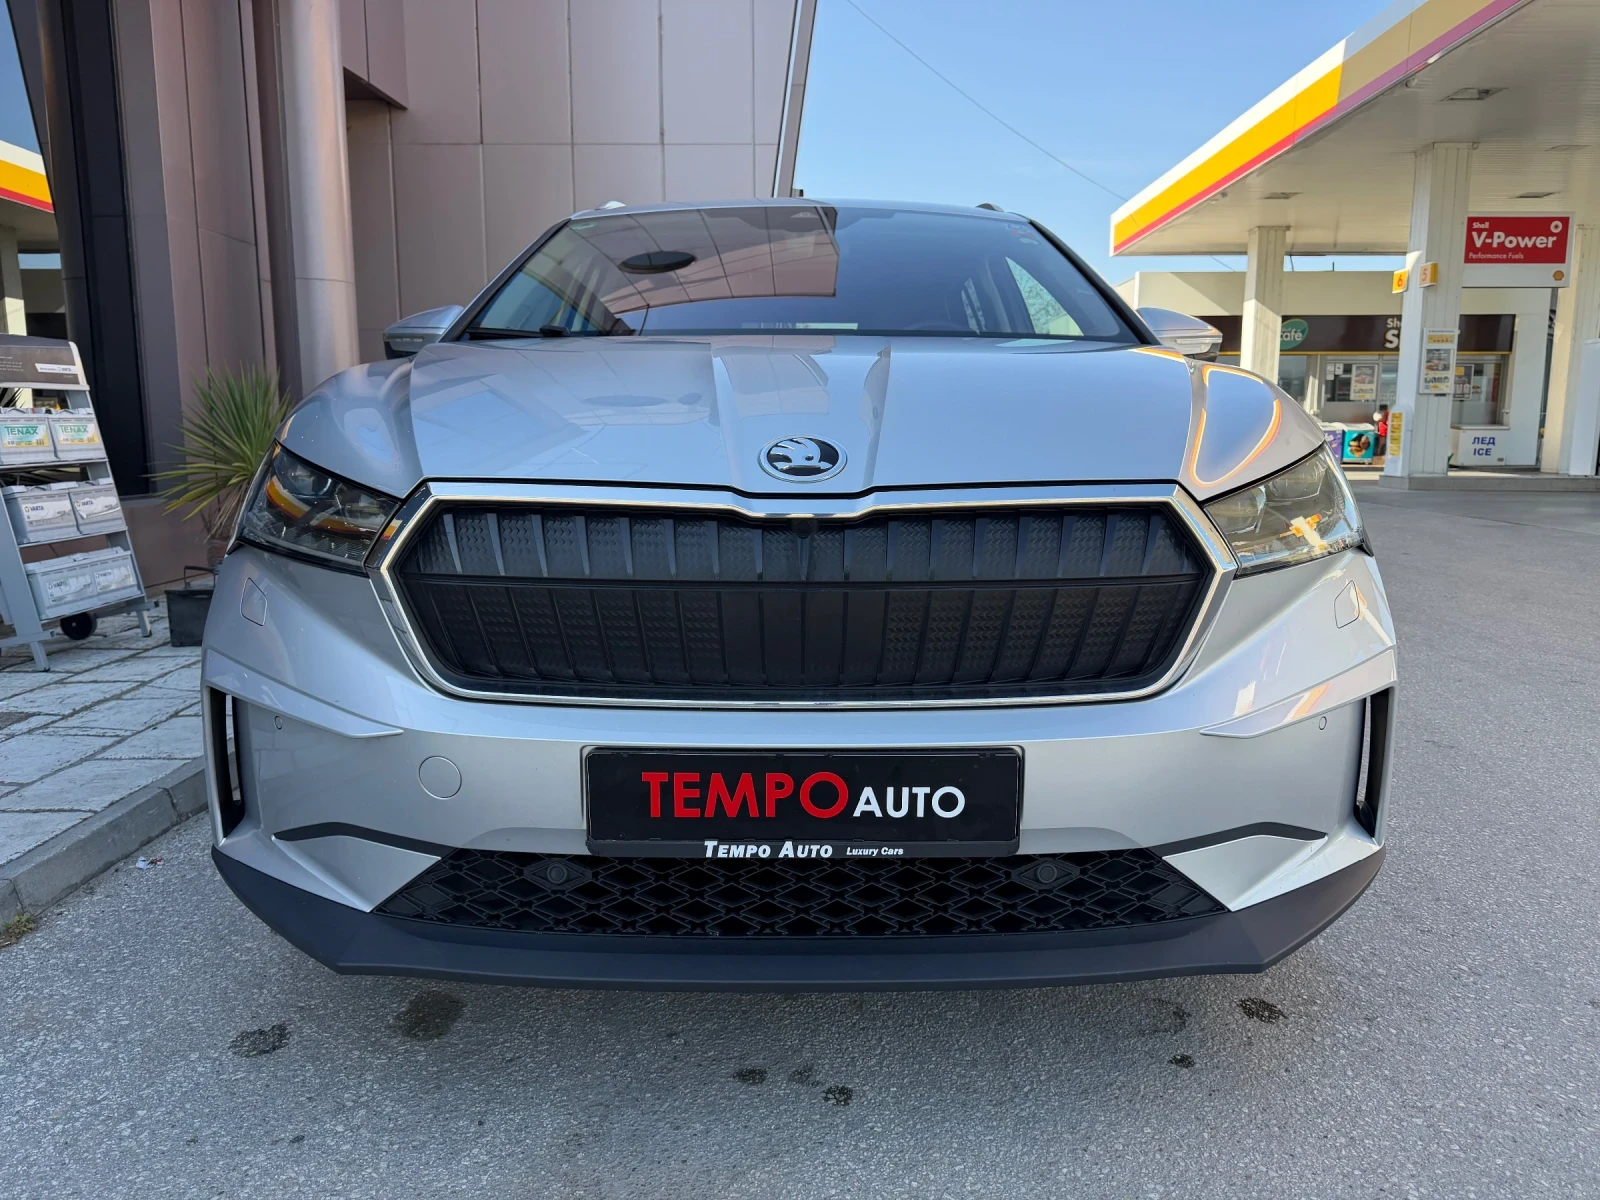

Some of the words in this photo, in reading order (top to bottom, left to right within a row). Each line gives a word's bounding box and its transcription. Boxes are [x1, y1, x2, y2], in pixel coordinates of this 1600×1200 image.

[1472, 231, 1557, 248] V-Power
[1397, 274, 1404, 287] 6
[1386, 317, 1401, 328] Sh
[1384, 329, 1399, 349] S
[4, 426, 39, 436] TENAX
[59, 424, 89, 434] TENAX
[1472, 436, 1496, 446] ЛЕД
[1473, 447, 1492, 456] ICE
[642, 771, 849, 819] TEMPO
[853, 785, 966, 819] AUTO
[847, 846, 879, 856] Luxury
[881, 847, 904, 855] Cars
